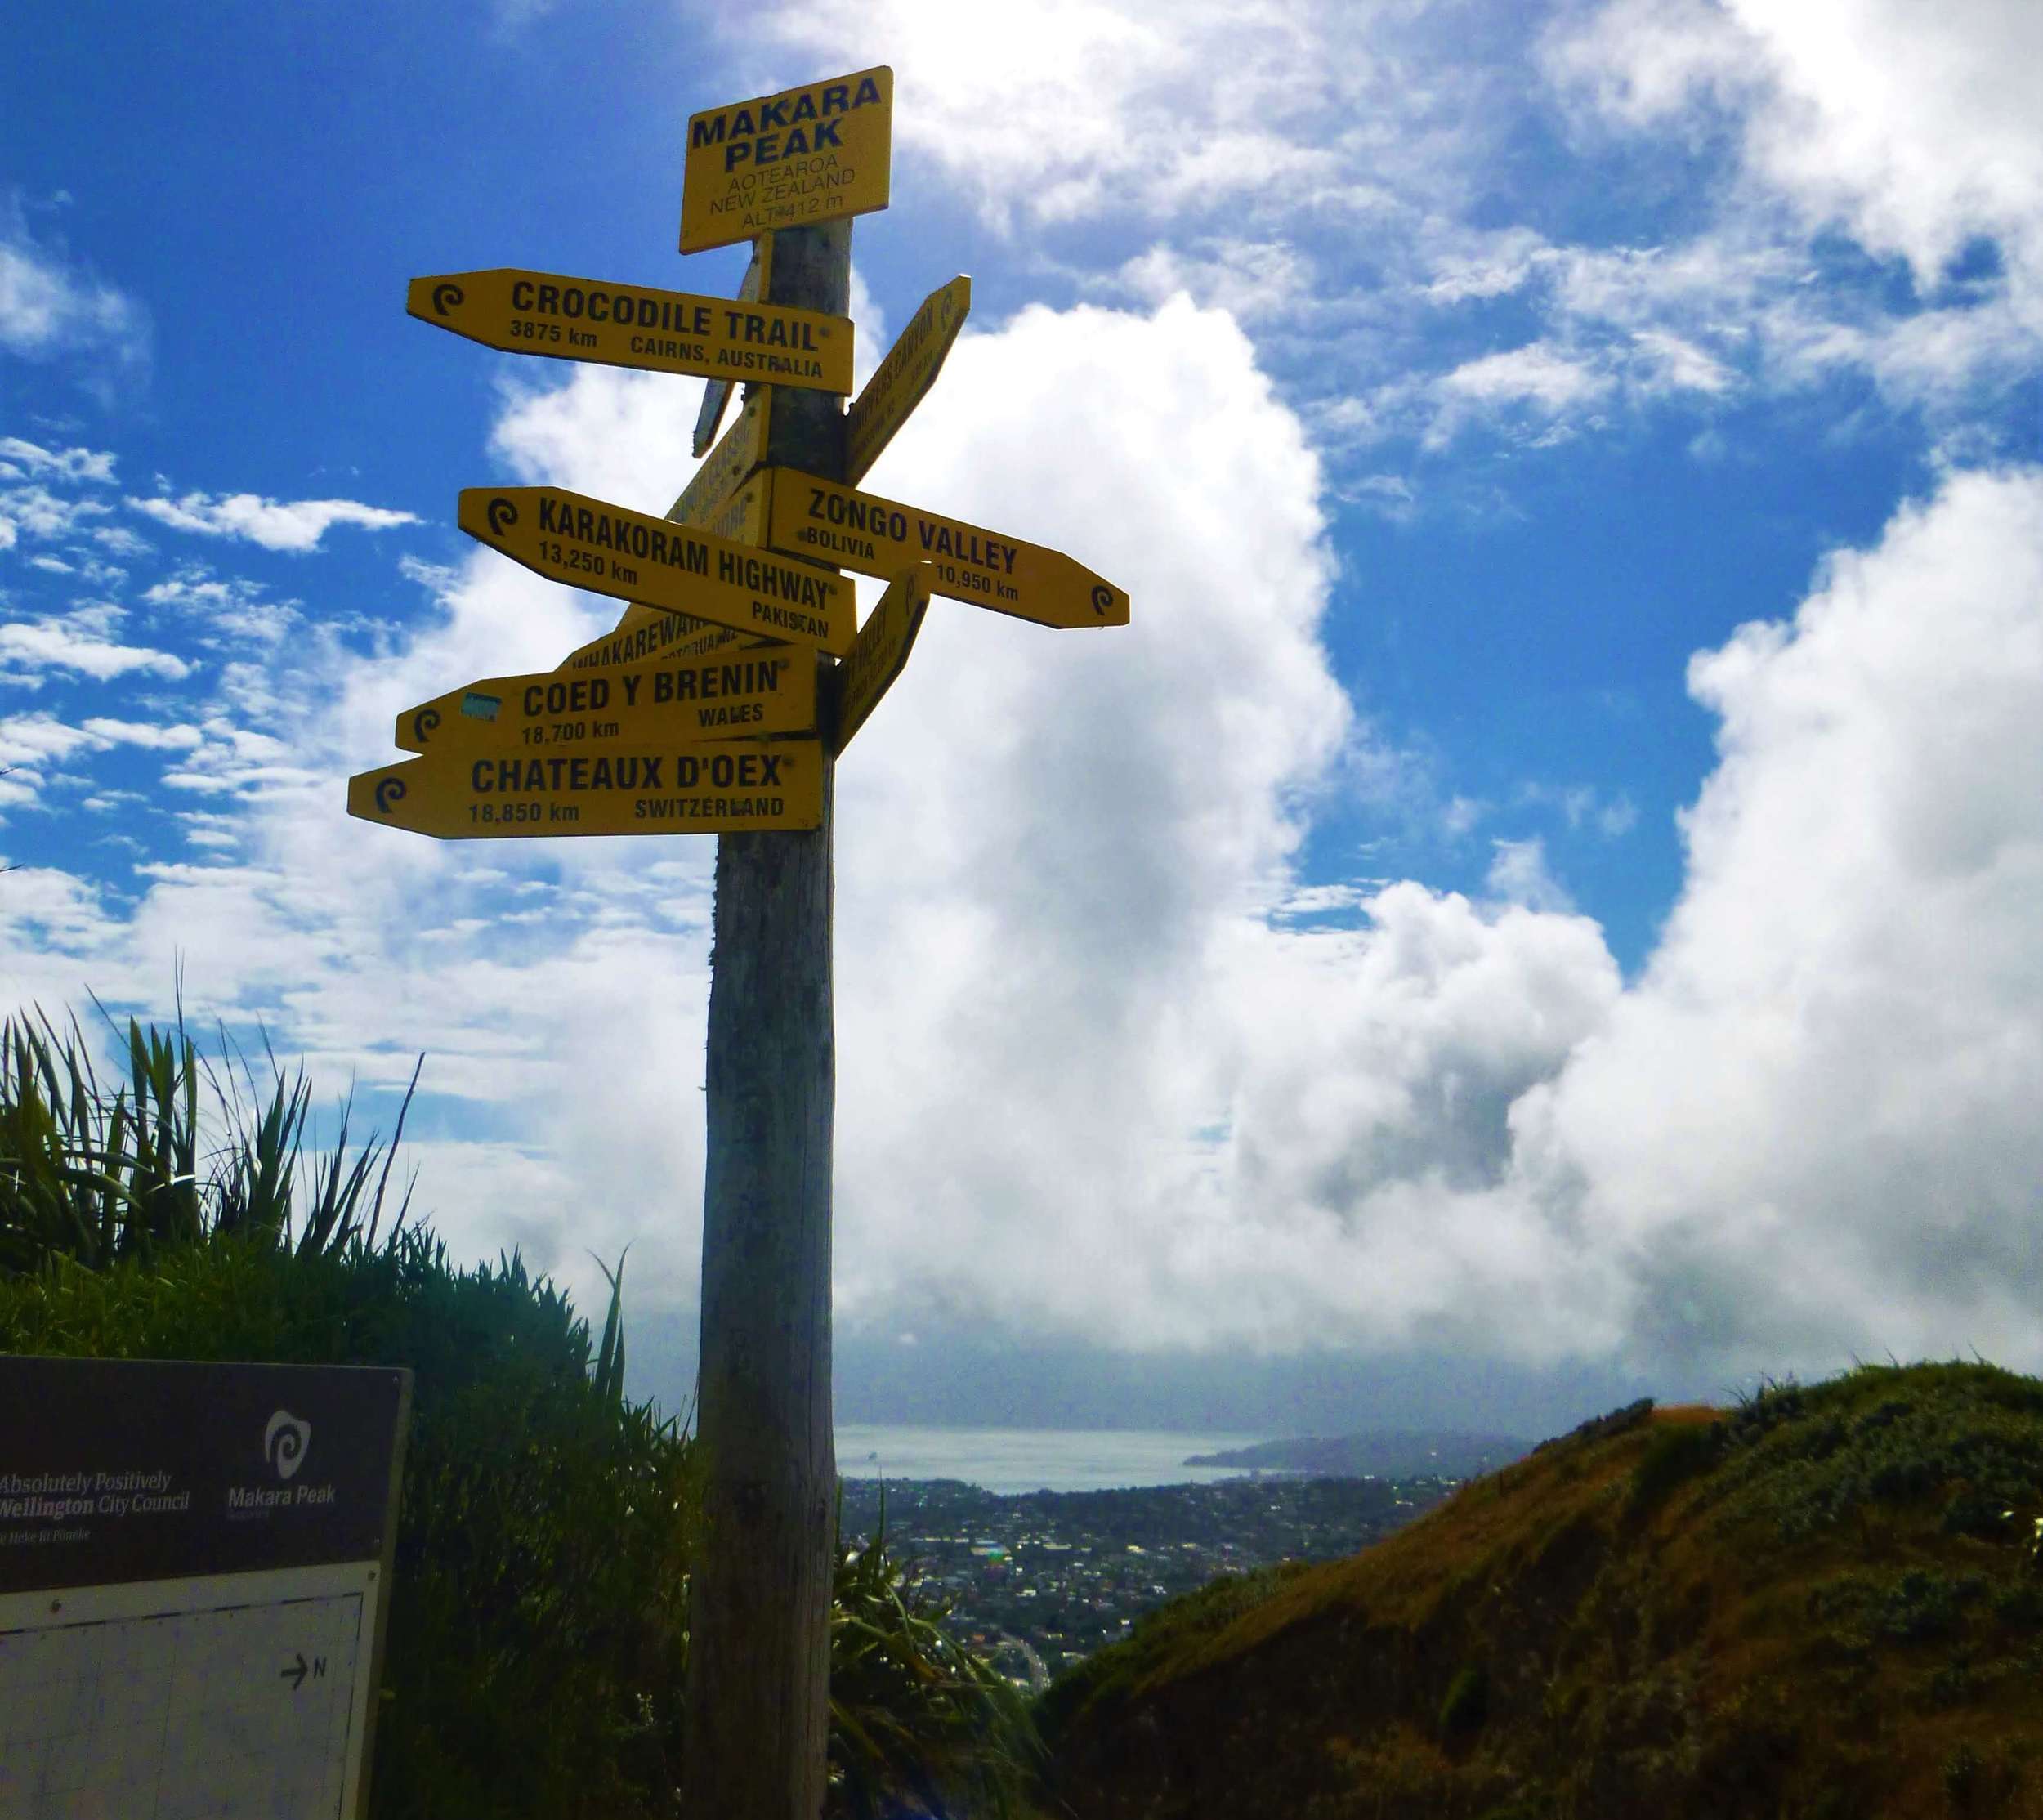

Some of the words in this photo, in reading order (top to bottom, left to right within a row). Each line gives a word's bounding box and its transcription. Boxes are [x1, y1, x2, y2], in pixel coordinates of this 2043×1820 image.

[692, 77, 881, 149] MAKARA
[725, 118, 843, 173] PEAK
[710, 190, 756, 216] NEW
[763, 168, 856, 203] ZEALAND
[728, 154, 838, 192] AOTEAROA
[512, 280, 712, 337] CROCODILE
[725, 311, 819, 352] TRAIL
[510, 320, 561, 342] 3875
[569, 327, 597, 348] km
[631, 336, 711, 366] CAIRNS,
[717, 347, 823, 380] AUSTRALIA
[539, 496, 709, 577] KARAKORAM
[718, 549, 829, 611] HIGHWAY
[808, 488, 908, 542] ZONGO
[918, 519, 1017, 575] VALLEY
[539, 539, 605, 577] 13,250
[611, 558, 638, 586] km
[752, 600, 829, 639] PAKISTAN
[807, 525, 875, 561] BOLIVIA
[936, 563, 991, 595] 10,950
[997, 584, 1019, 602] km
[523, 677, 610, 718] COED
[622, 674, 642, 706] Y
[655, 660, 778, 704] BRENIN
[521, 722, 586, 745] 18,700
[593, 720, 619, 738] km
[699, 703, 764, 727] WALES
[472, 758, 663, 794] CHATEAUX
[677, 754, 782, 789] D'OEX
[549, 803, 579, 822] km
[635, 798, 784, 818] SWITZERLAND
[0, 1471, 92, 1496] Absolutely
[95, 1469, 172, 1492] Positively
[0, 1496, 94, 1520] Wellington
[98, 1495, 130, 1517] City
[132, 1491, 190, 1512] Council
[228, 1484, 292, 1508] Makara
[297, 1482, 336, 1505] Peak
[314, 1656, 328, 1679] N
